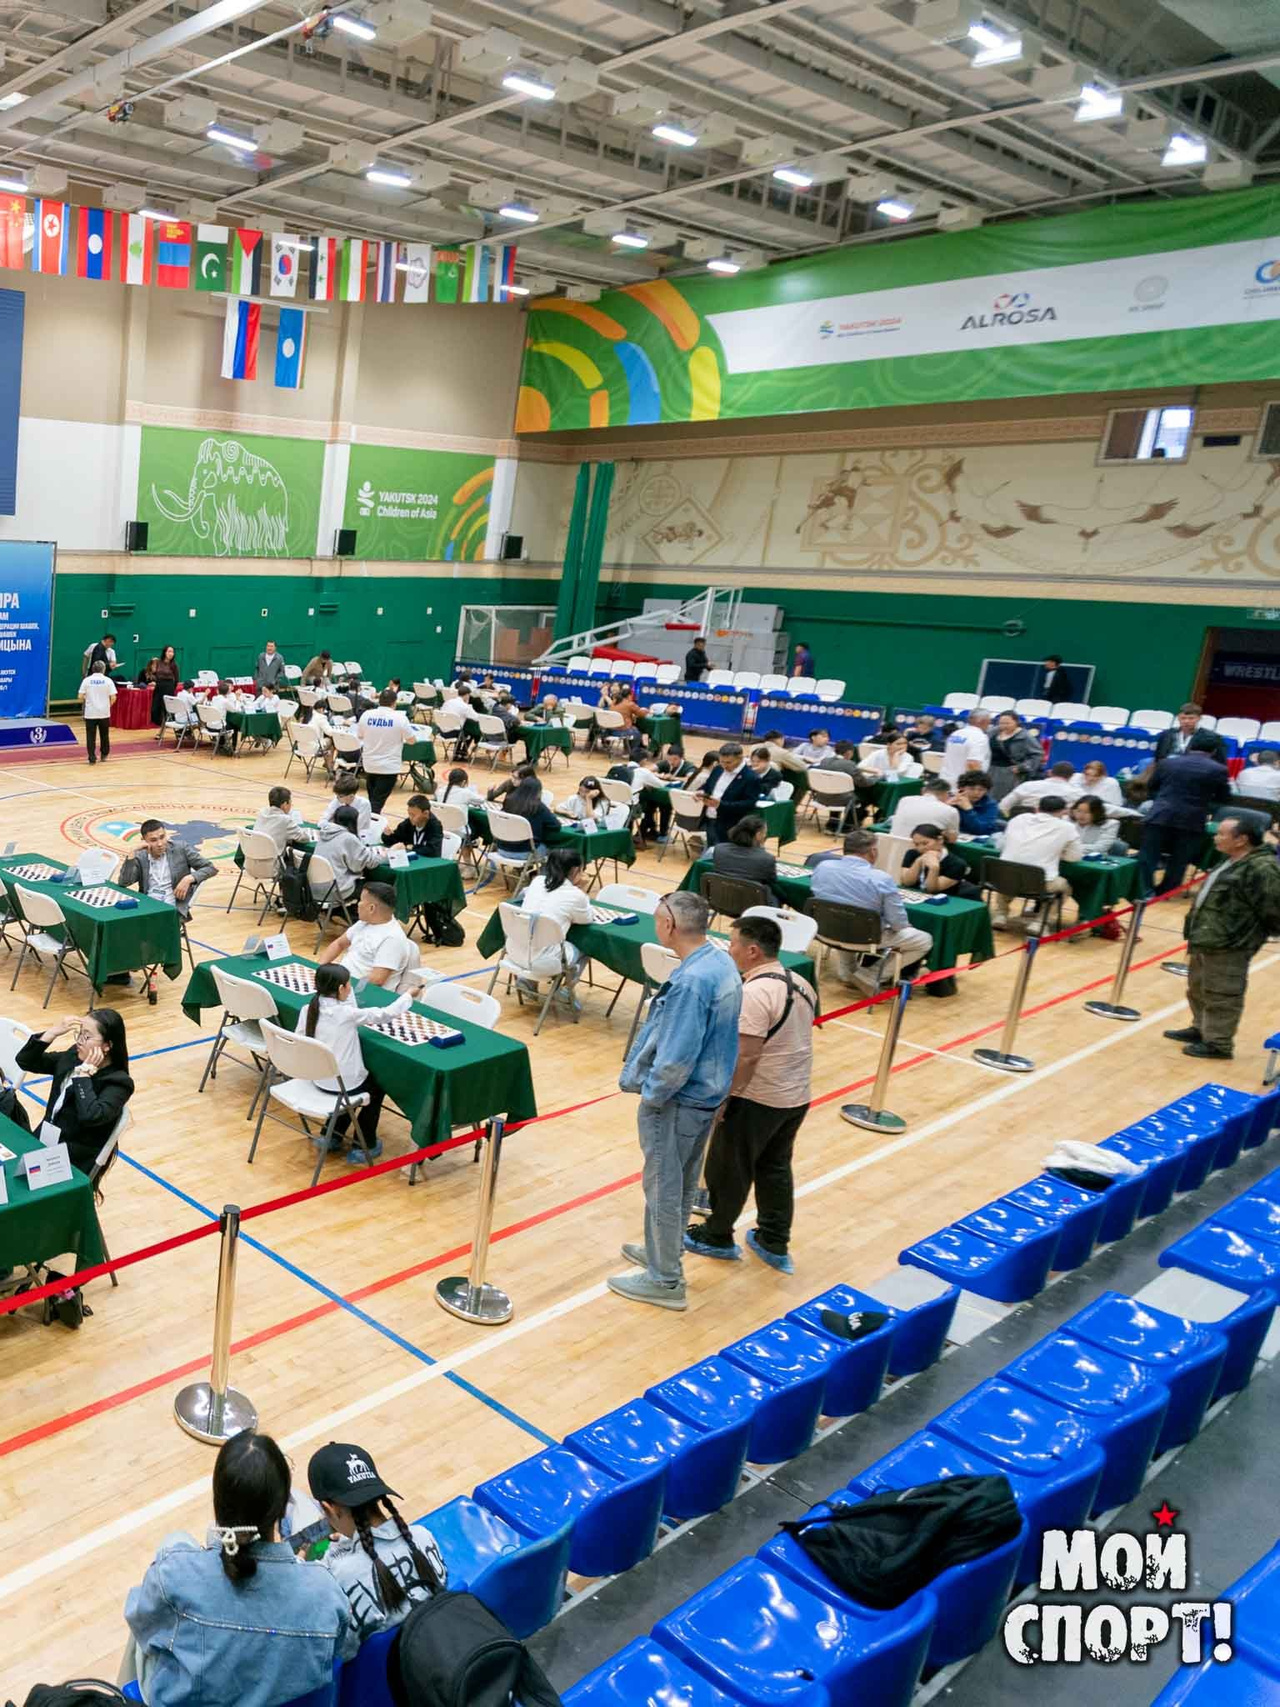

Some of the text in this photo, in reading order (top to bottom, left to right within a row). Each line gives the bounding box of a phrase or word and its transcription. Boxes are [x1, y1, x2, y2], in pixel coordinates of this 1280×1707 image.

[960, 307, 1057, 331] ALROSA
[379, 492, 439, 505] YAKUTSK 2024
[377, 505, 437, 519] Children of Asia
[34, 727, 43, 740] 3
[347, 1471, 376, 1483] YAKUTIA
